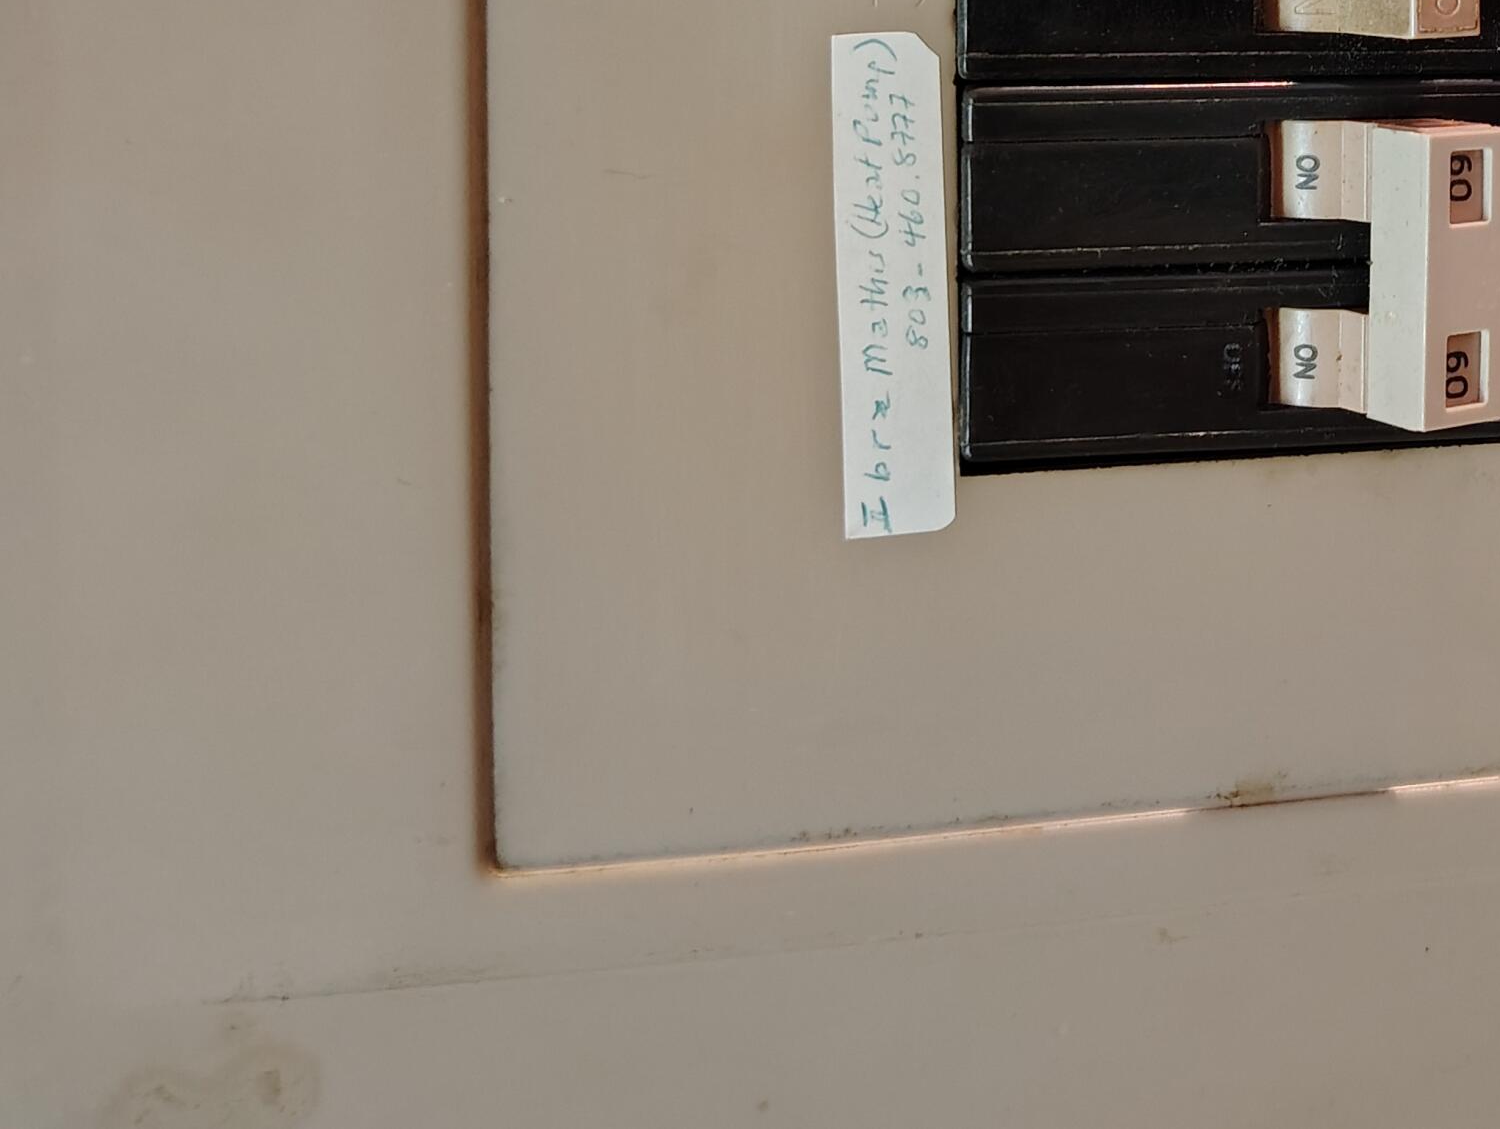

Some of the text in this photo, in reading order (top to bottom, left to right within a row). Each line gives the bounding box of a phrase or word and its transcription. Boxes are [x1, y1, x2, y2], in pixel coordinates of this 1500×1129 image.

[853, 39, 896, 146] Pump)
[1295, 154, 1320, 190] ON
[1450, 154, 1472, 202] 60
[851, 157, 889, 239] (Heat
[859, 250, 893, 376] Mathis
[1293, 343, 1318, 380] ON
[1446, 350, 1469, 399] 60
